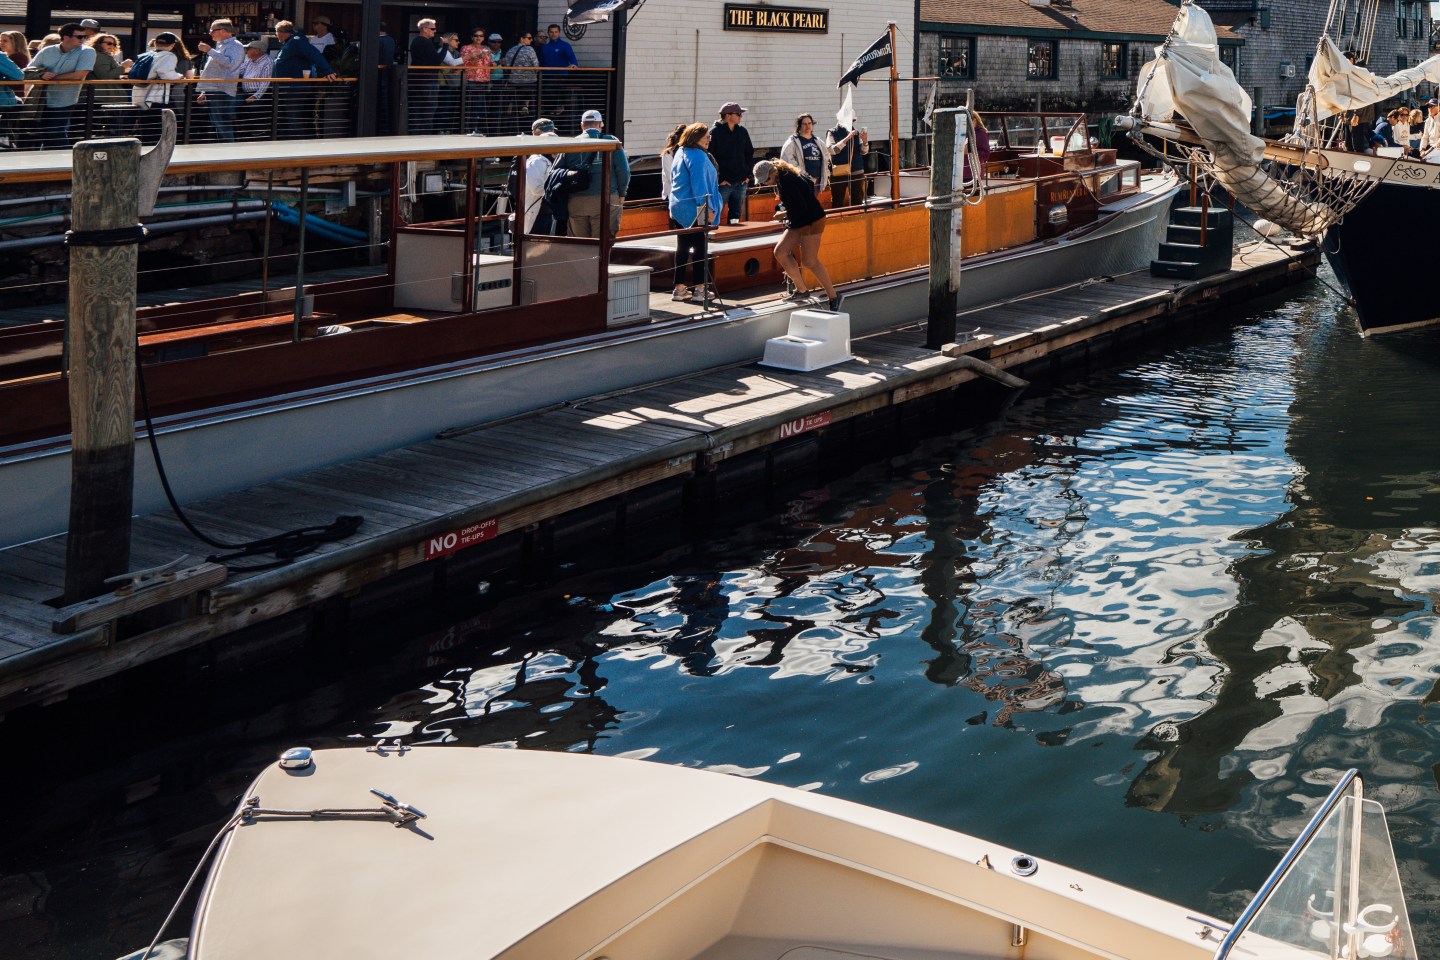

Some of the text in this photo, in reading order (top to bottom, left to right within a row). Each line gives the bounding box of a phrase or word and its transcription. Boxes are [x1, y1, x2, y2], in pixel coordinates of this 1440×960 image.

[730, 10, 826, 29] THE BLACK PEARL
[780, 417, 805, 438] NO
[430, 518, 496, 555] NO DROP-OFFS
[461, 531, 485, 544] TIE-UPS
